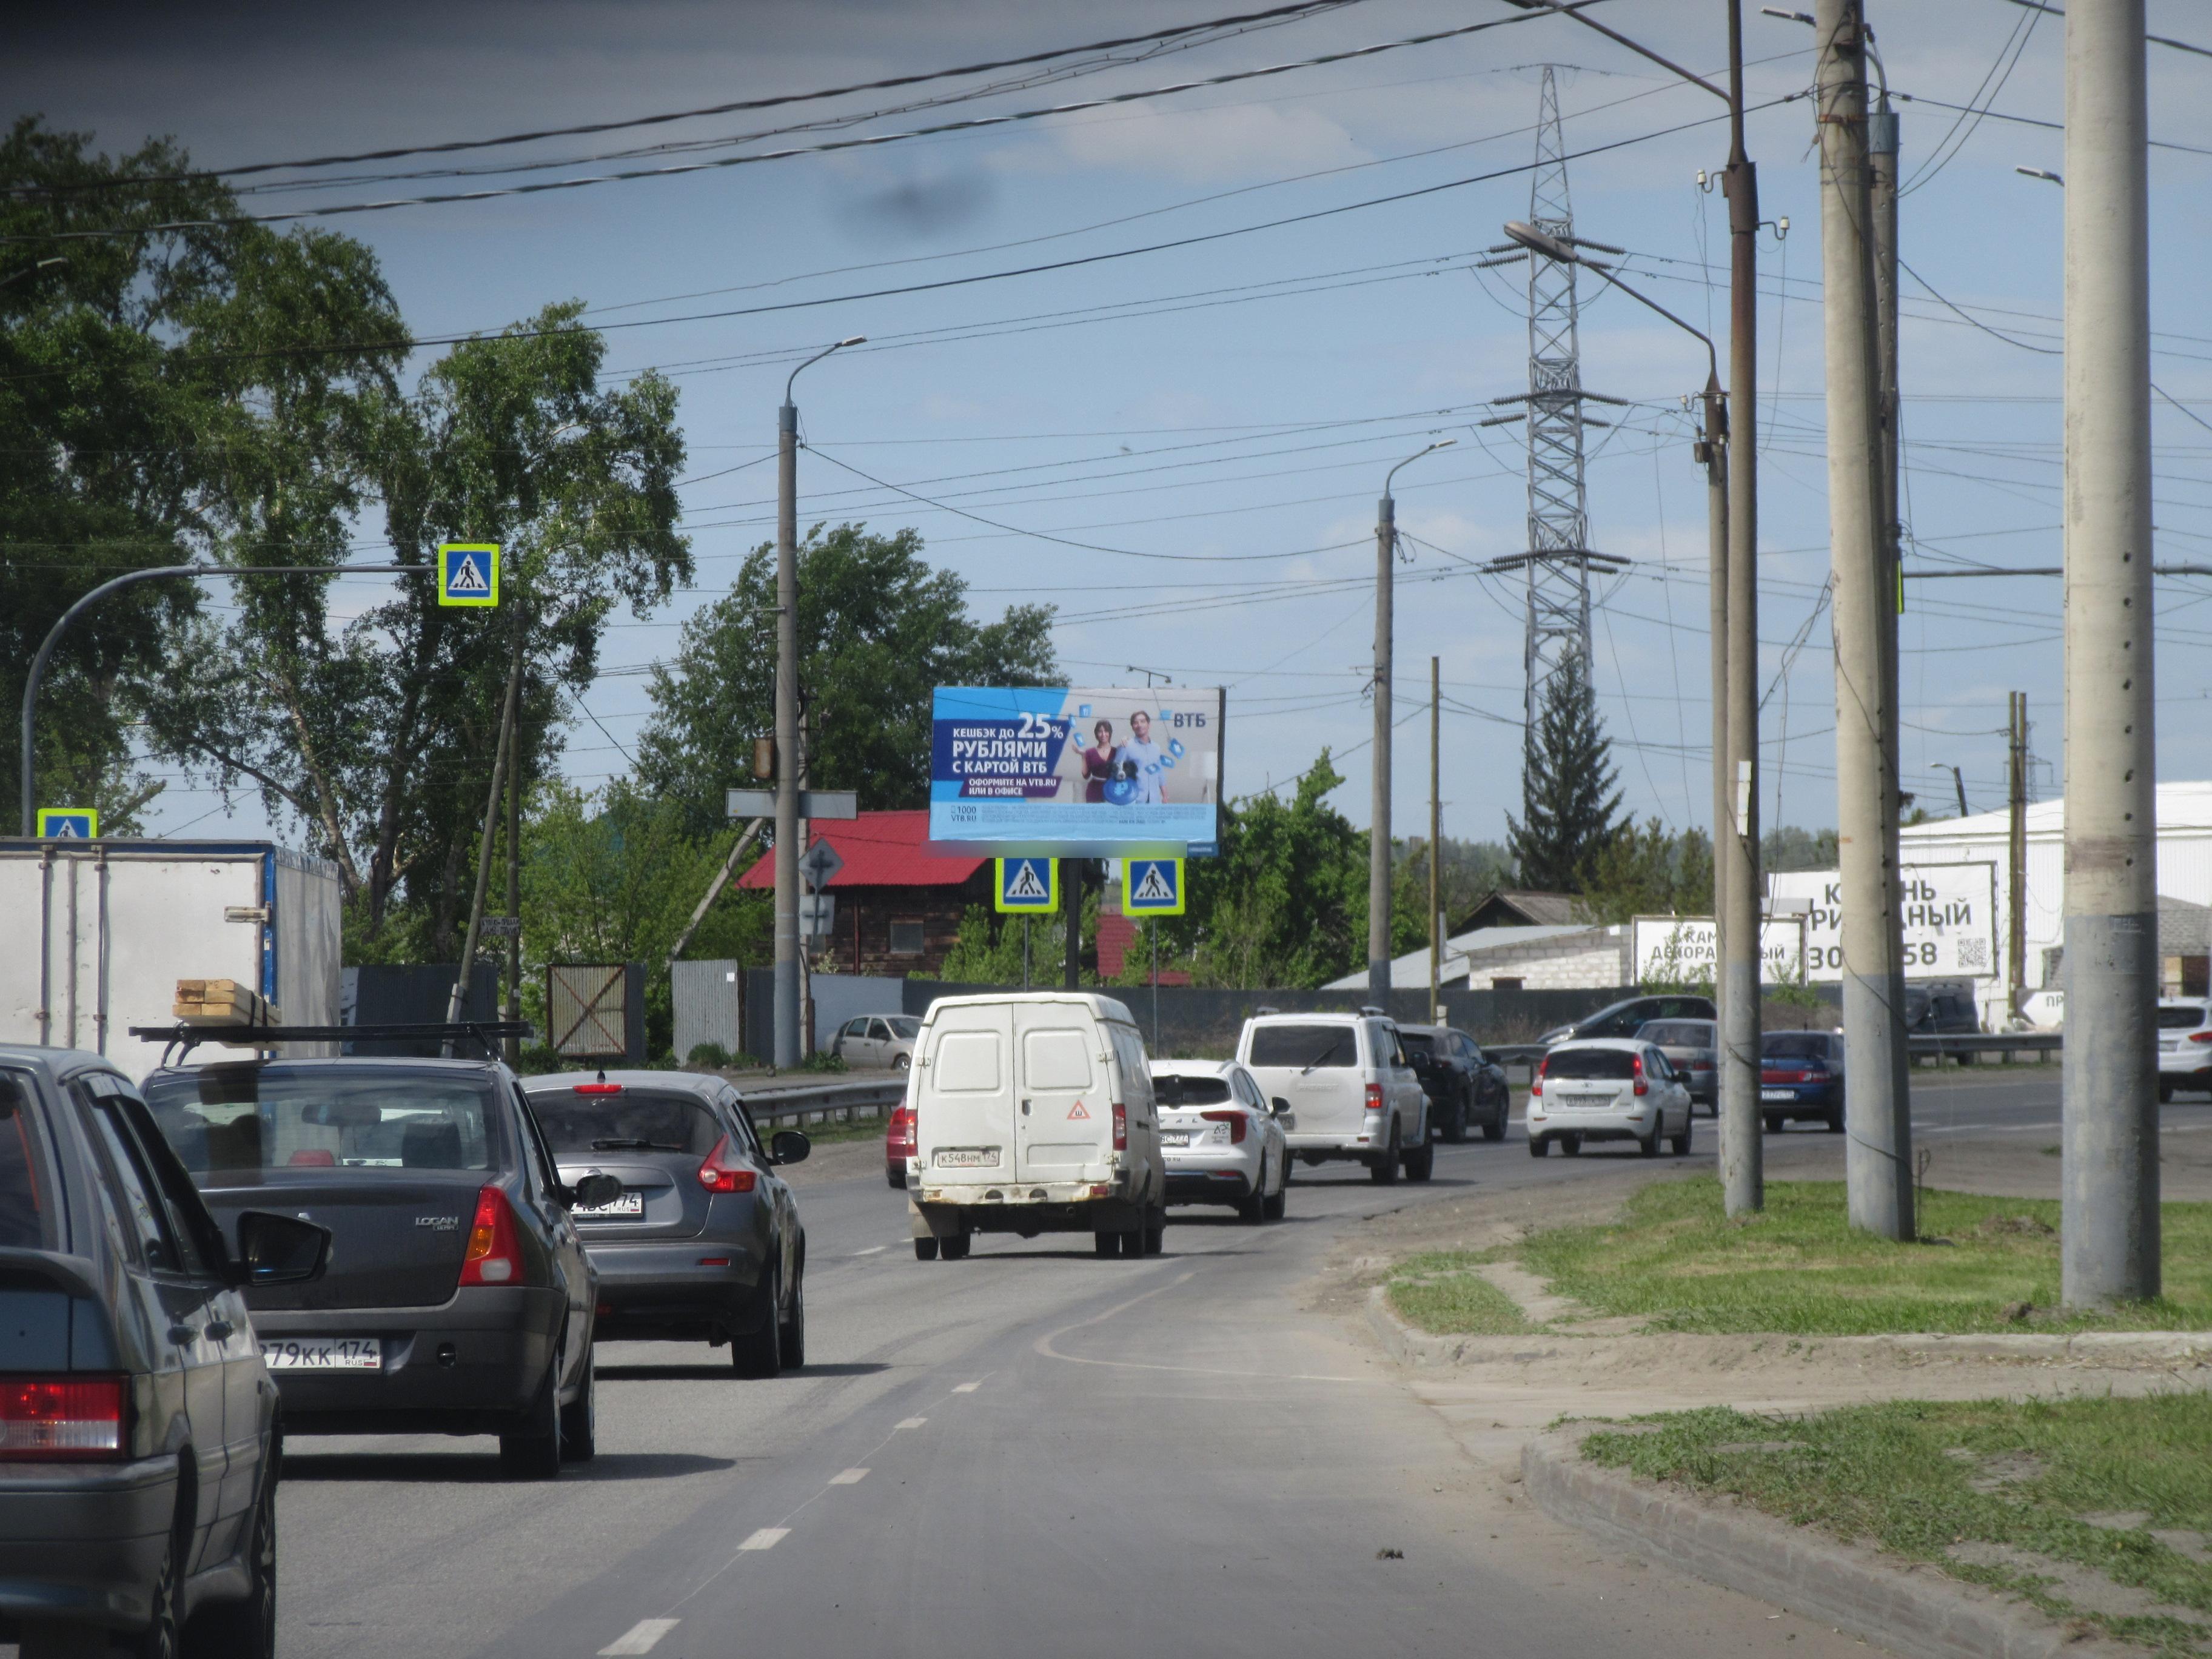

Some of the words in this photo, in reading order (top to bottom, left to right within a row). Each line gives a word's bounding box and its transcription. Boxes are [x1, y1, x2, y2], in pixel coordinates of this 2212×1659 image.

[953, 728, 996, 738] КЕШБЭК
[999, 728, 1014, 739] ДО
[1018, 712, 1064, 739] 25%
[1174, 712, 1206, 728] ВТБ
[953, 740, 1047, 758] РУБЛЯМИ
[953, 761, 960, 773] С
[965, 759, 1019, 773] КАРТОЙ
[1023, 762, 1047, 774] ВТБ
[969, 778, 1014, 786] ОФОРМИТЕ
[994, 787, 1023, 796] ОФИСЕ
[415, 1216, 460, 1226] LOGAN
[338, 1341, 375, 1359] 174
